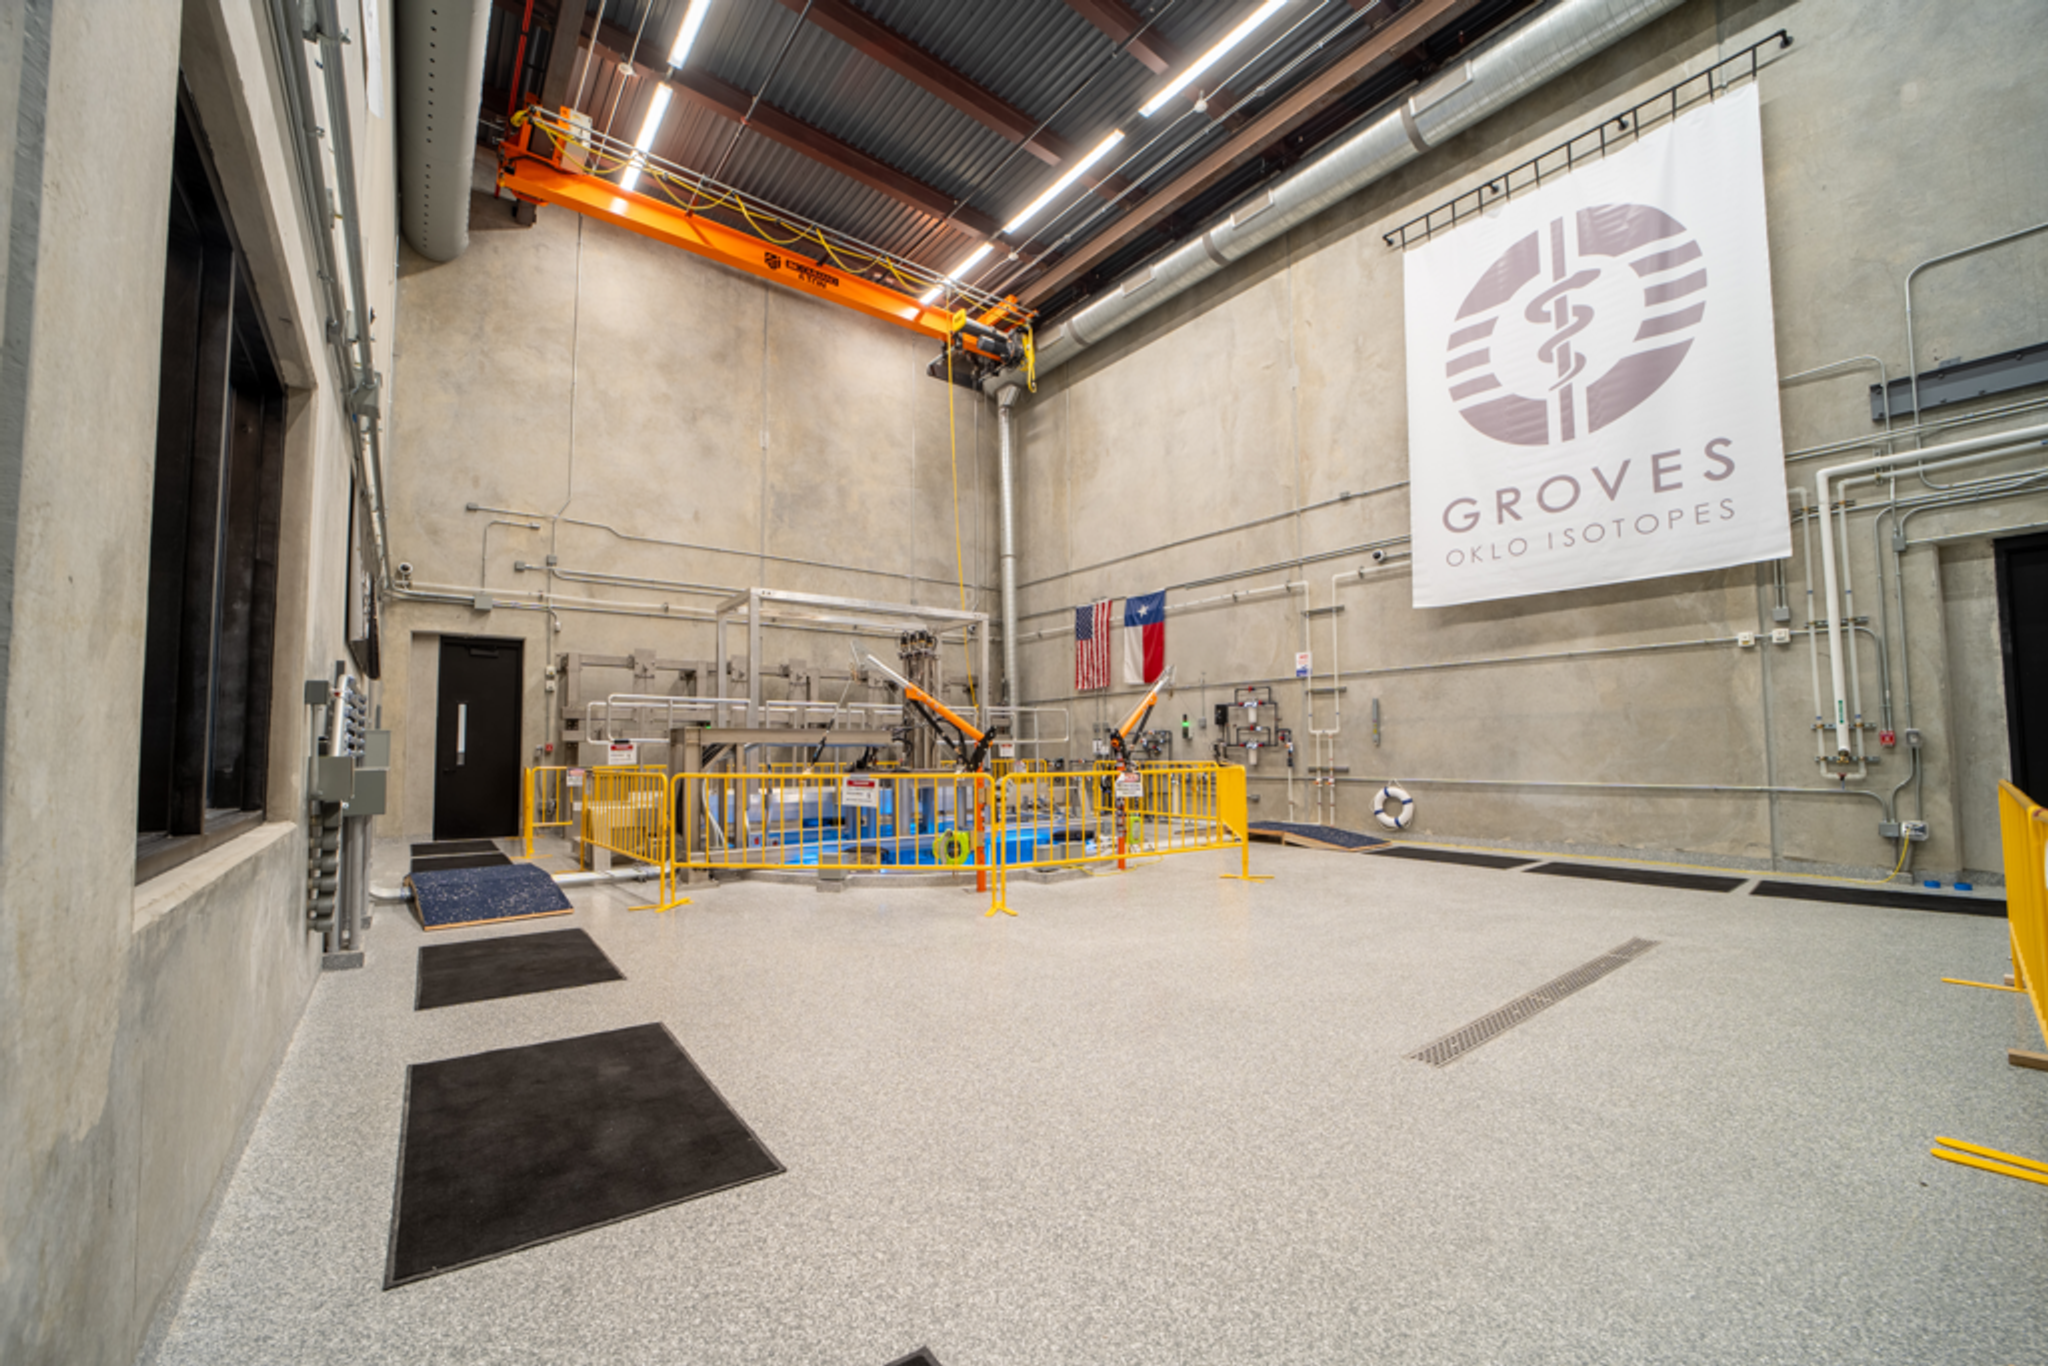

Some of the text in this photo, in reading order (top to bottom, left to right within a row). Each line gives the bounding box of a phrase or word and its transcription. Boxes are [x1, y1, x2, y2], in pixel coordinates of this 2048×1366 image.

[1442, 437, 1736, 533] GROVES
[1446, 498, 1736, 567] OKLO ISOTOPES
